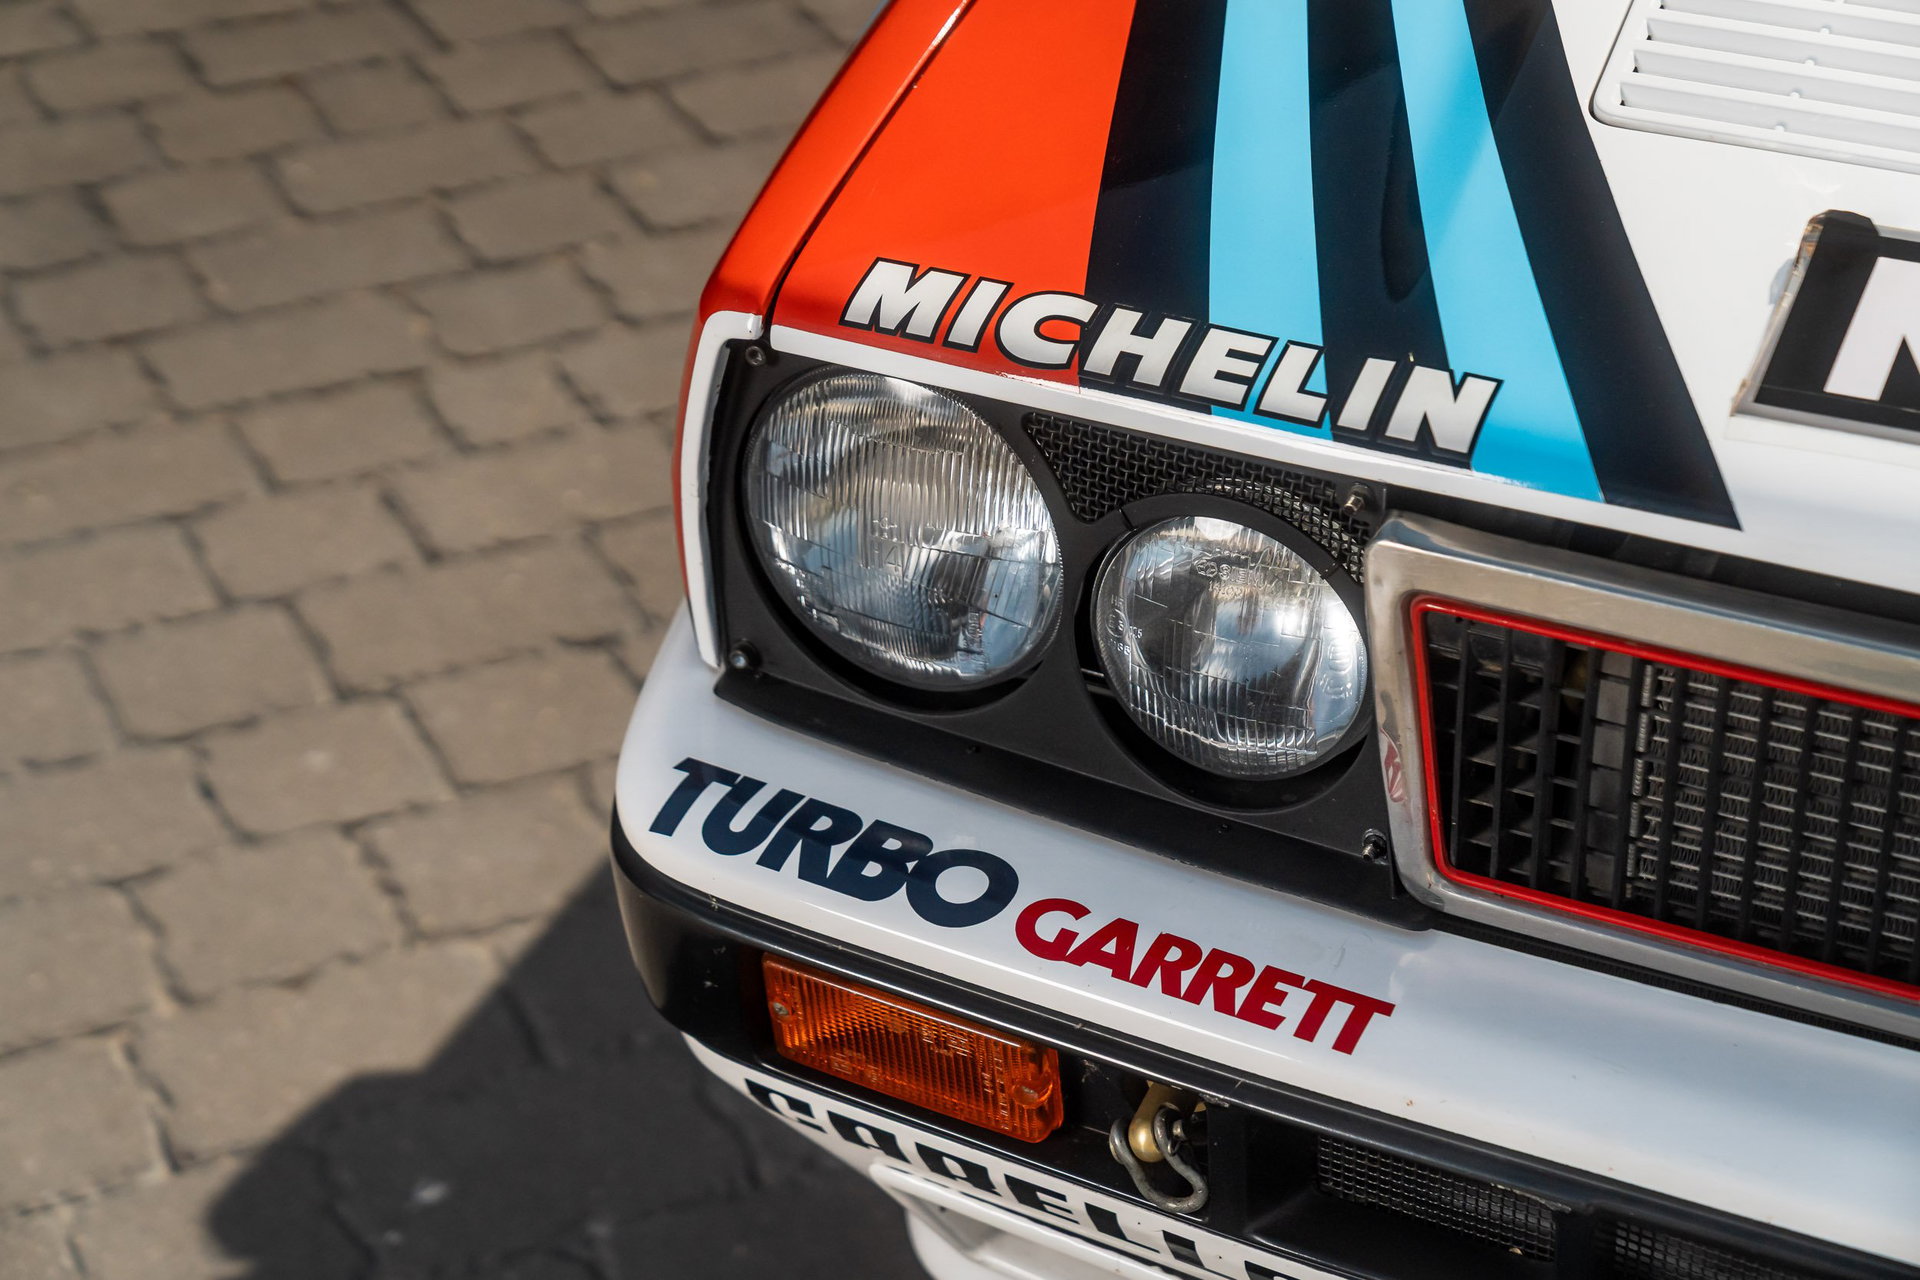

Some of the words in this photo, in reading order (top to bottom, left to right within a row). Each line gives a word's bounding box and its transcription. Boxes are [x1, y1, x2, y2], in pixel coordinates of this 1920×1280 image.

[840, 258, 1503, 465] MICHELIN
[649, 757, 1019, 928] TURBO
[1015, 898, 1395, 1056] GARRETT
